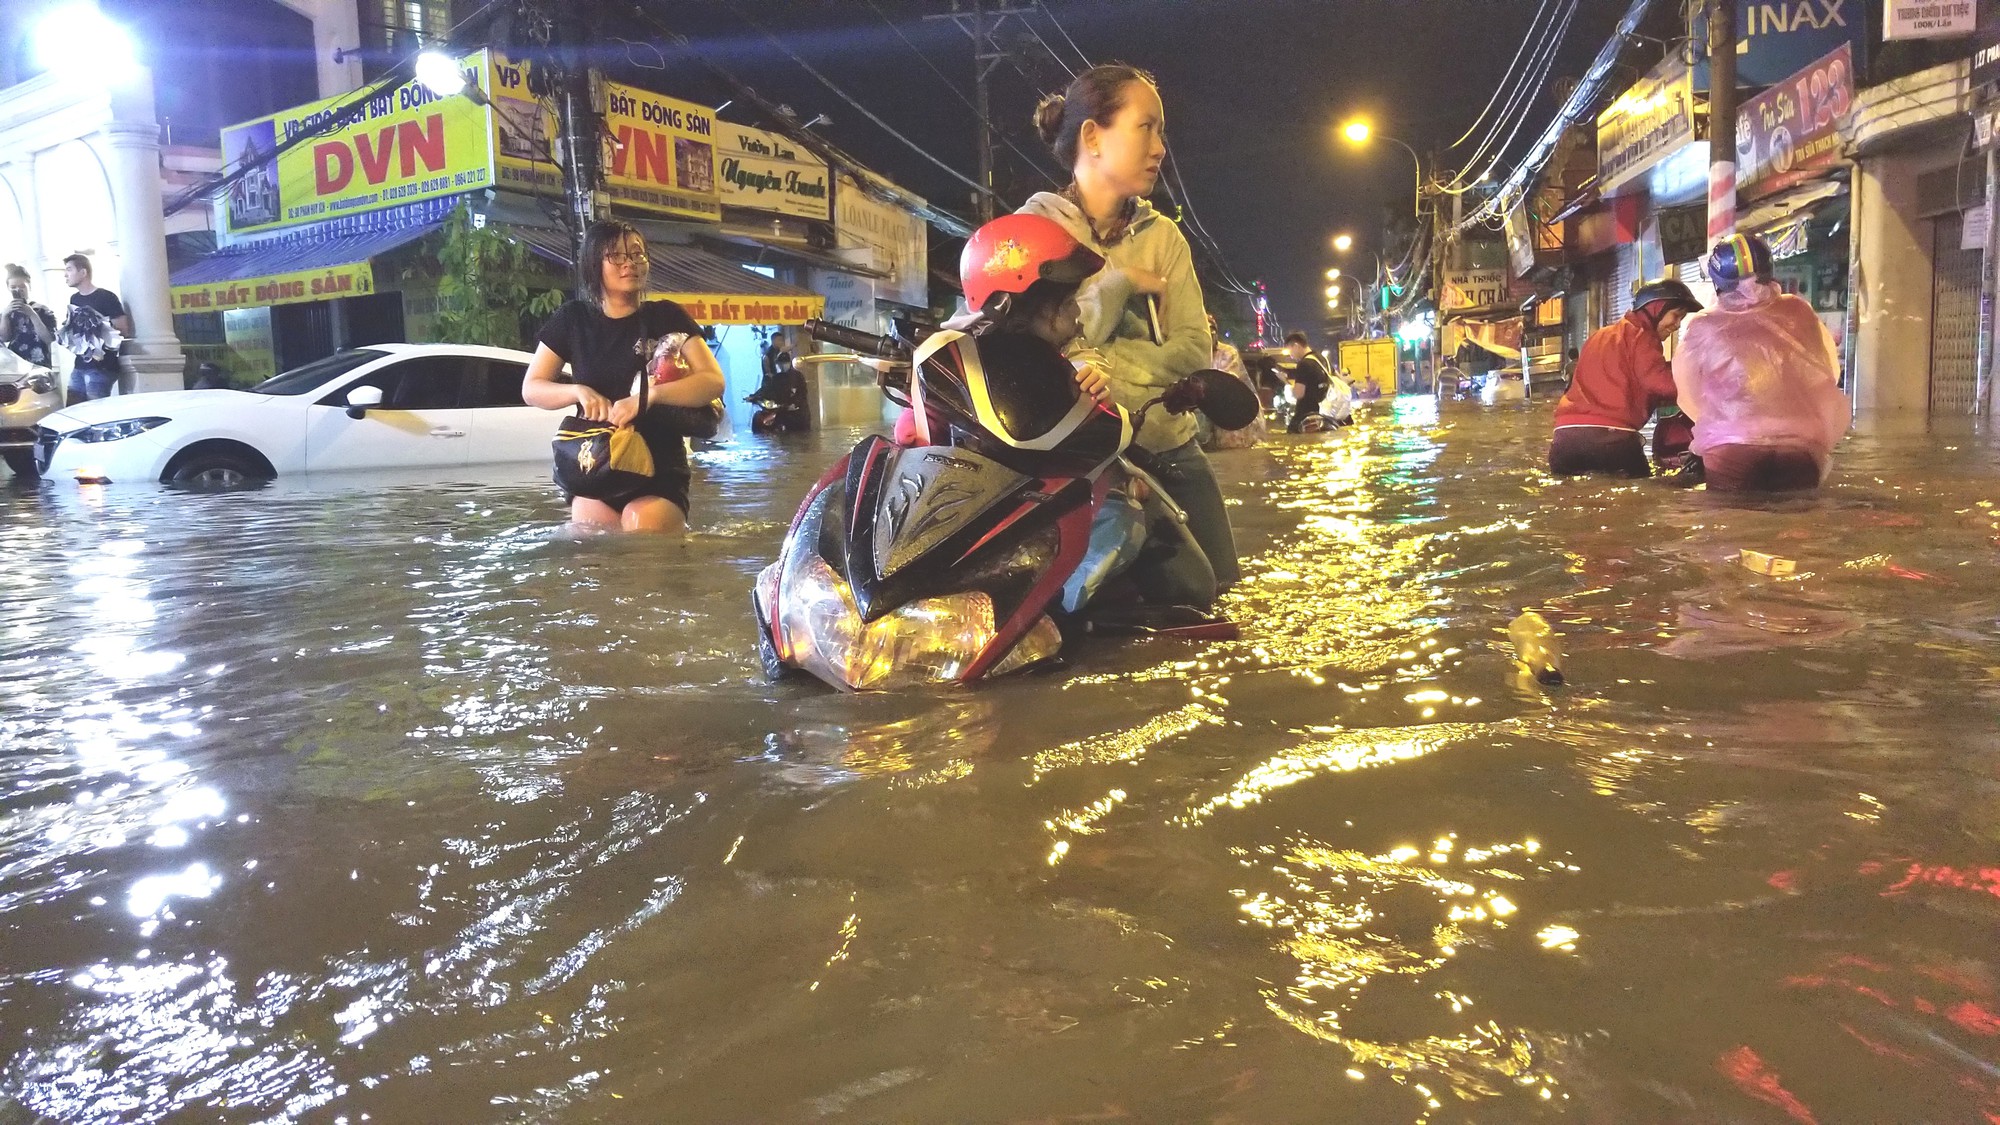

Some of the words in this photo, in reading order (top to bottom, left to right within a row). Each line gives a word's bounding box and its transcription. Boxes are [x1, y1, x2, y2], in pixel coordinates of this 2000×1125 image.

[1748, 0, 1847, 35] INAX
[497, 64, 520, 89] VP
[610, 89, 636, 117] BẤT
[642, 100, 682, 129] ĐỘNG
[685, 109, 711, 136] SẢN
[1796, 59, 1850, 135] 123
[313, 113, 446, 196] DVN
[738, 134, 770, 155] Vườn
[774, 142, 796, 160] Lan
[721, 157, 782, 194] Nguyên
[180, 288, 211, 308] PHÊ
[215, 283, 250, 306] BẤT
[255, 279, 305, 303] ĐỘNG
[310, 270, 353, 295] SẢN
[686, 299, 707, 320] HÊ
[710, 298, 740, 320] BẤT
[743, 300, 781, 324] ĐỘNG
[783, 300, 809, 320] SẢN
